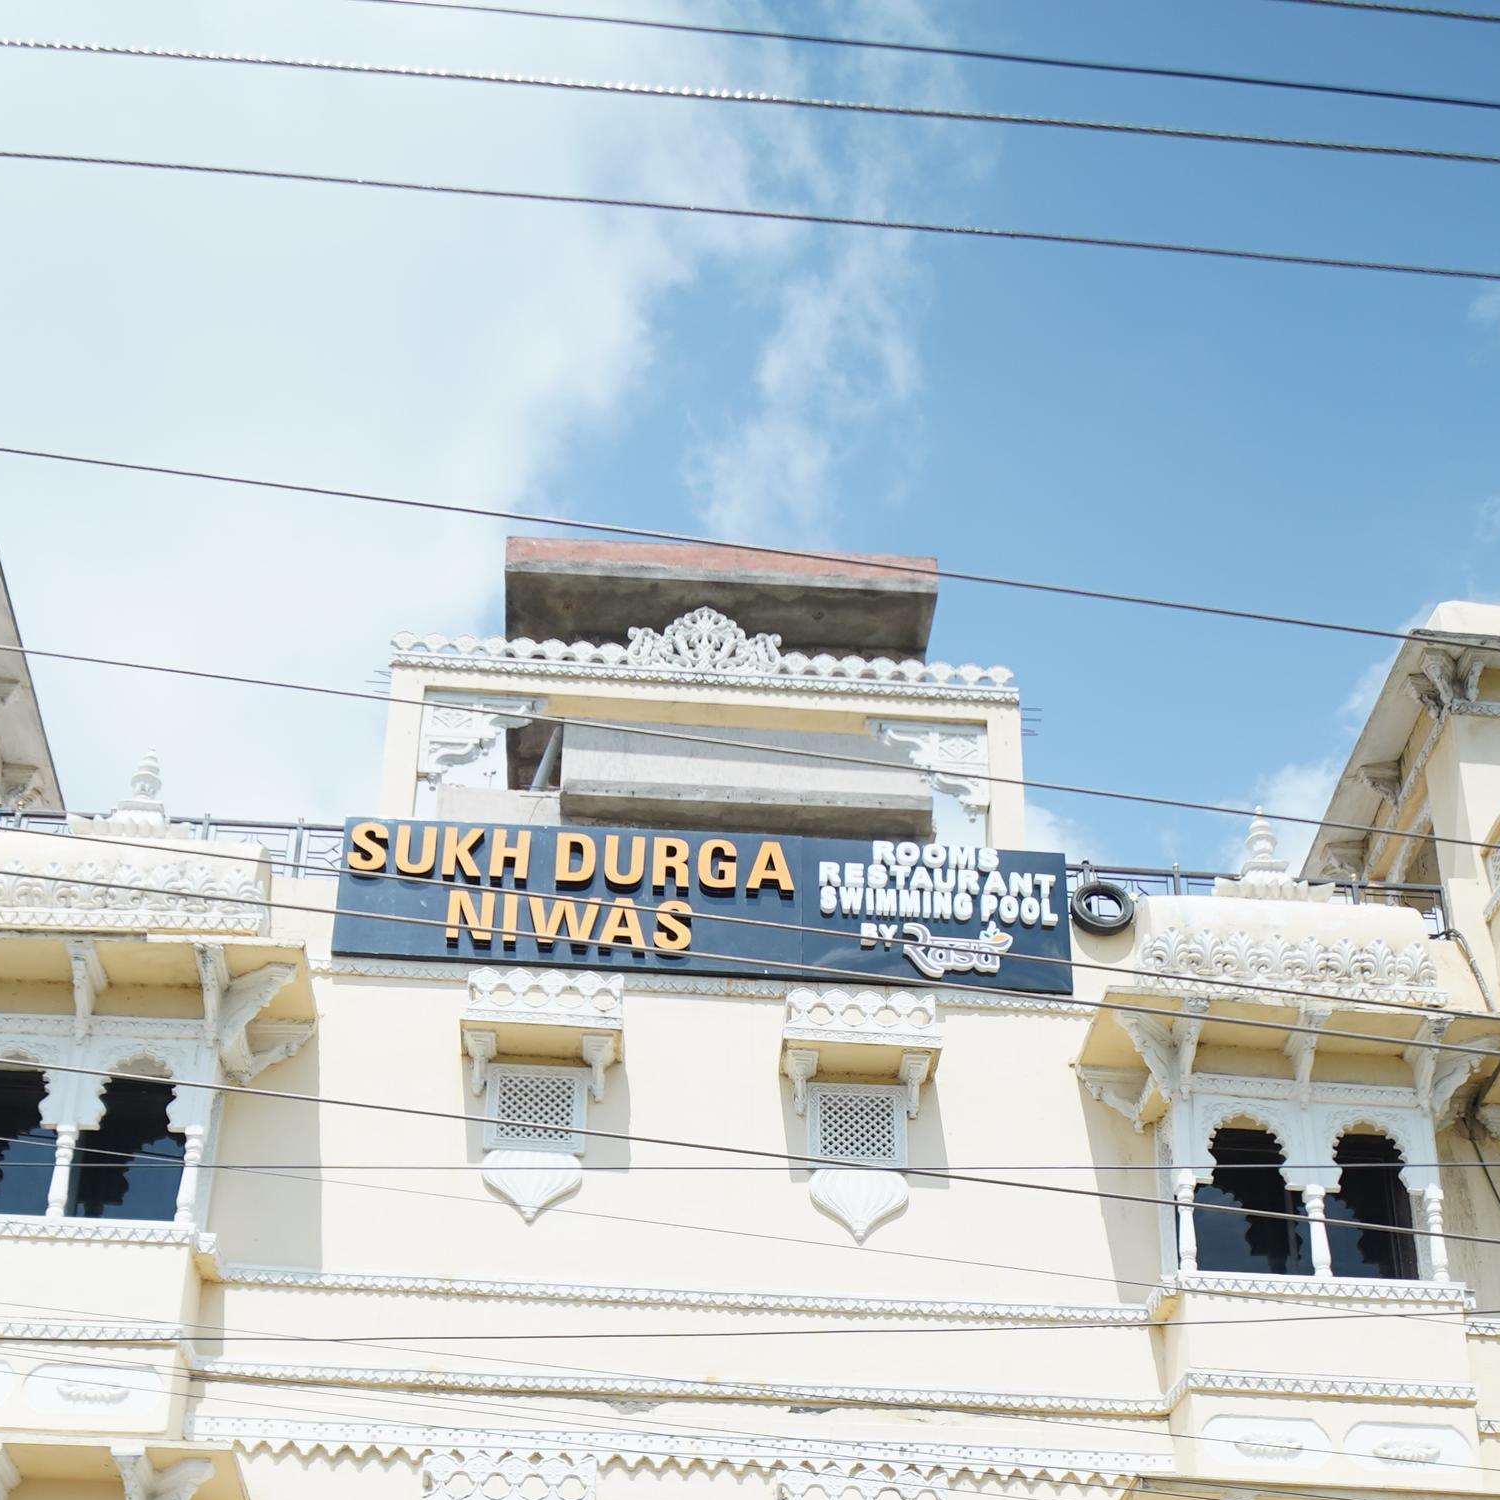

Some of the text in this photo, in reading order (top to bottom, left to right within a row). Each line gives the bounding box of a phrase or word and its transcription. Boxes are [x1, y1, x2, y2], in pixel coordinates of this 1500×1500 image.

[347, 821, 796, 897] SUKH DURGA
[872, 840, 999, 872] ROOMS
[818, 861, 1056, 898] RESTAURANT
[445, 889, 693, 956] NIWAS
[819, 886, 1059, 926] SWIMMING POOL
[860, 922, 898, 948] BY
